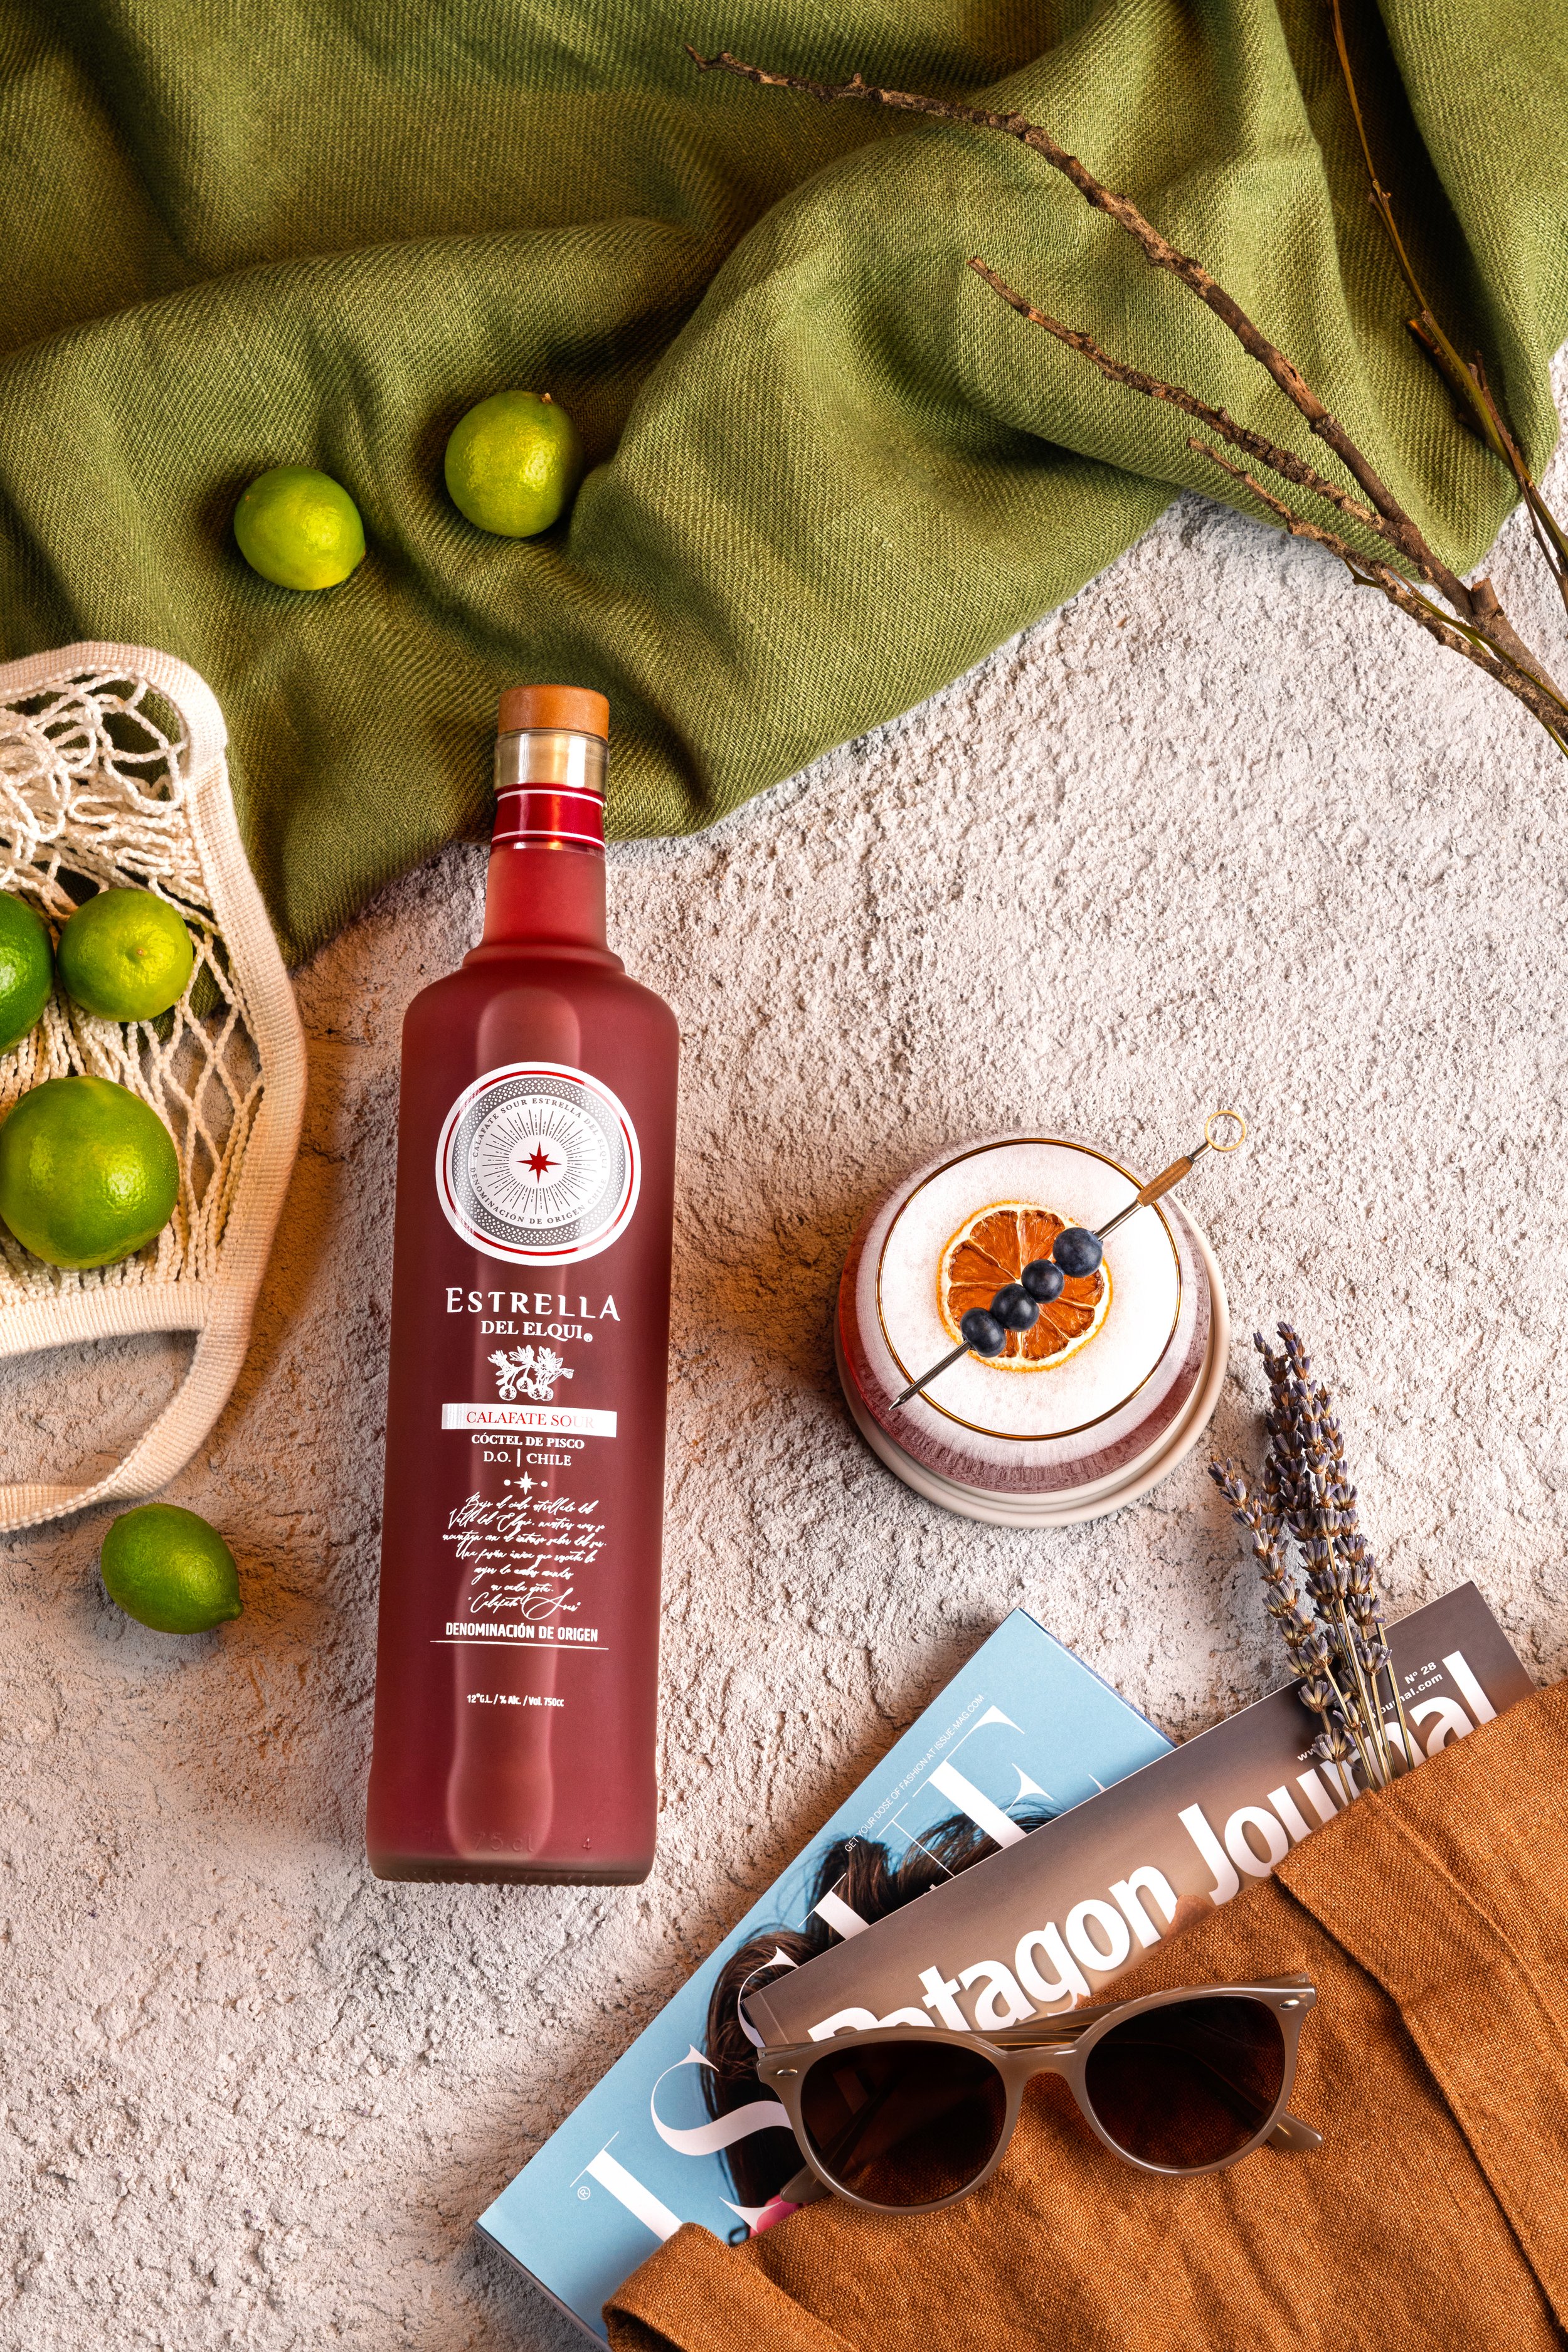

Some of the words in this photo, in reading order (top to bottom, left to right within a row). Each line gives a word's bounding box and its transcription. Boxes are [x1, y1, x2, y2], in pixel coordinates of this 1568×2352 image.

[472, 1113, 499, 1157] CALAFATE
[500, 1099, 528, 1114] SOUR
[532, 1098, 582, 1119] ESTRELLA
[583, 1118, 599, 1136] DEL
[598, 1138, 608, 1168] ELQUI
[470, 1167, 524, 1223] DENOMINACIÓN
[547, 1204, 586, 1224] ORIGEN
[587, 1179, 608, 1205] CHILE
[445, 1287, 621, 1322] ESTRELLA
[480, 1320, 519, 1335] DEL
[466, 1411, 548, 1426] CALAFATE
[551, 1415, 594, 1429] SOUR
[471, 1432, 523, 1446] CÓCTEL
[524, 1436, 544, 1448] DE
[546, 1438, 585, 1449] PISCO
[483, 1451, 512, 1463] D.O.
[526, 1453, 572, 1466] CHILE
[445, 1622, 535, 1638] DENOMINACIÓN
[538, 1626, 554, 1640] DE
[557, 1627, 598, 1642] ORIGEN
[1421, 1661, 1437, 1676] 28
[845, 1836, 860, 1853] GET
[857, 1816, 877, 1837] YOUR
[874, 1798, 894, 1819] DOSE
[891, 1787, 902, 1800] OF
[899, 1758, 929, 1791] FASHION
[923, 1748, 936, 1761] AT
[933, 1694, 985, 1751] ISSUE-MAG.COM
[808, 1865, 1179, 2042] tagon
